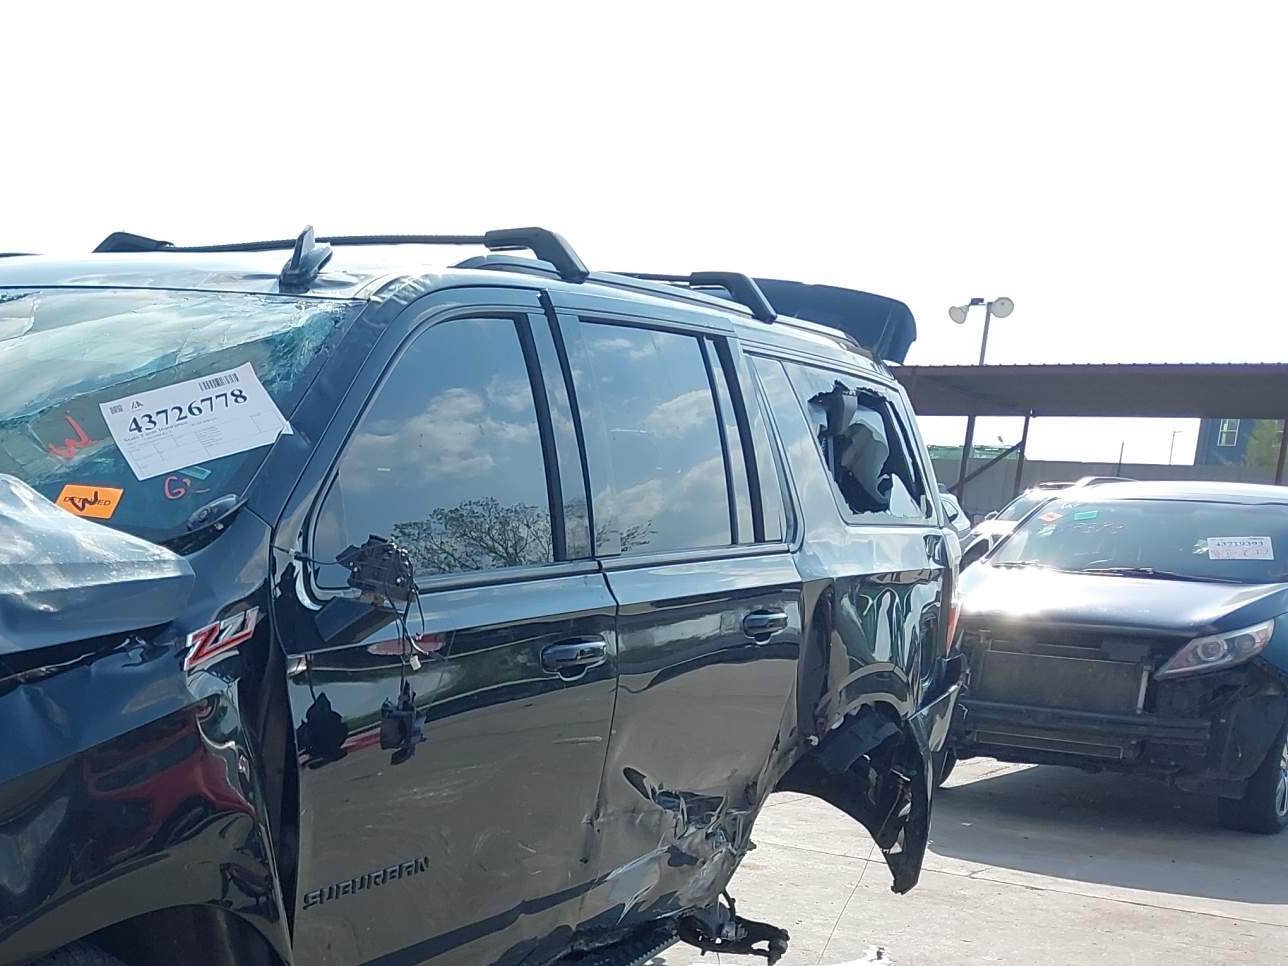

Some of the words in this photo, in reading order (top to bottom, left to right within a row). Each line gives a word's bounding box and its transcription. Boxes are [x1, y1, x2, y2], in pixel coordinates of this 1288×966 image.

[128, 388, 248, 434] 43726778
[184, 606, 260, 671] Z71
[302, 856, 431, 911] SUBURBAN
